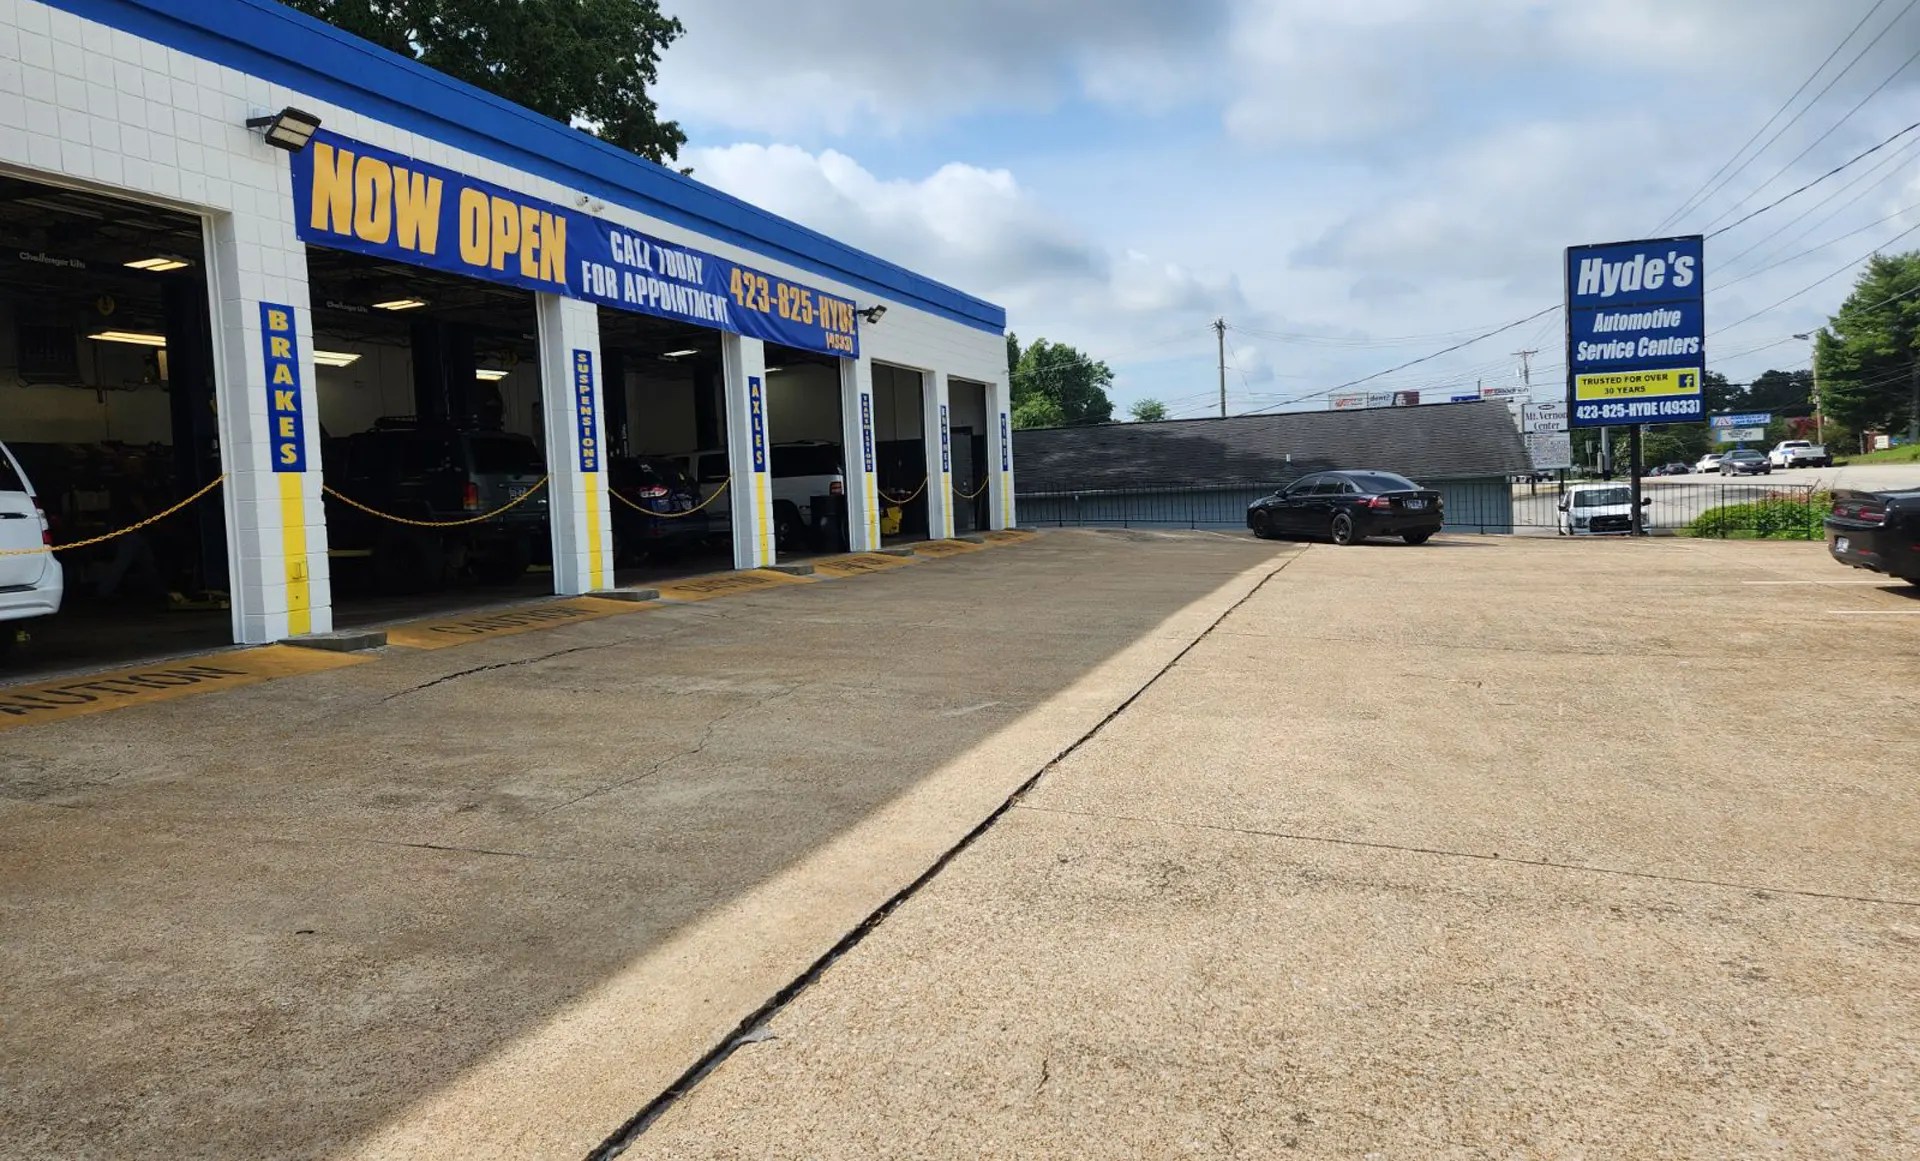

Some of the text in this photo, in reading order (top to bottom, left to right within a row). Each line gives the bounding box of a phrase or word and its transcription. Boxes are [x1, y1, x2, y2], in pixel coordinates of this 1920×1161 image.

[311, 142, 567, 285] NOW OPEN
[610, 231, 703, 285] CALL TODAY
[1577, 251, 1695, 297] Hyde's
[582, 260, 729, 324] FOR APPOINTMENT
[730, 268, 857, 335] 423-825-HYDE
[1593, 308, 1681, 333] Automotive
[1577, 336, 1700, 361] Service Centers
[268, 309, 298, 464] BRAKES
[1582, 373, 1668, 386] TRUSTED FOR OVER
[1604, 385, 1646, 395] 30 YEARS
[577, 353, 595, 468] SUSPENSIONS
[751, 384, 763, 465] AXLES
[1534, 421, 1560, 430] Center
[1539, 410, 1568, 420] Vernon
[1576, 399, 1700, 419] 423-825-HYDE (4933)
[429, 606, 600, 635] CAUTION
